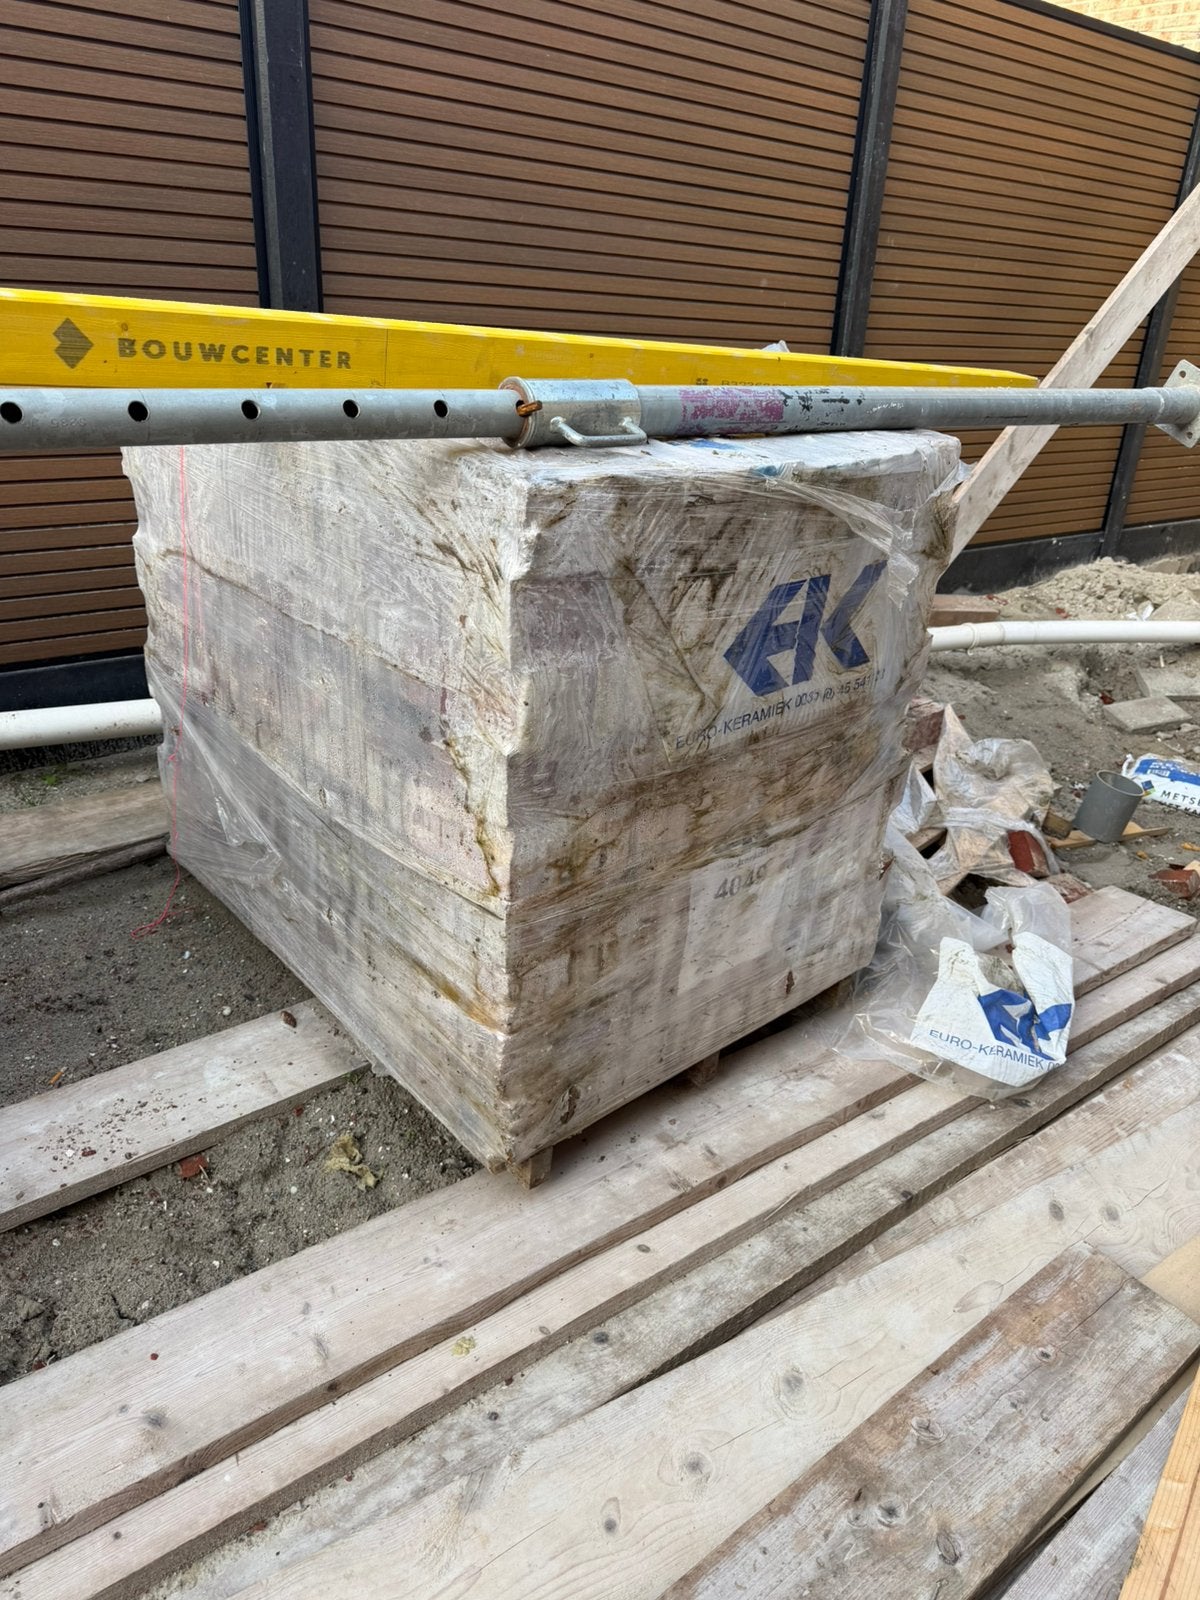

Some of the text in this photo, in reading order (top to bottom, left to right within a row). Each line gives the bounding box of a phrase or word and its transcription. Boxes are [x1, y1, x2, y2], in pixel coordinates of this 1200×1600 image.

[117, 337, 352, 370] BOUWCENTER
[675, 698, 793, 750] EURO-KERAMIEK
[928, 1029, 1045, 1071] EURO-KERAMIEK
